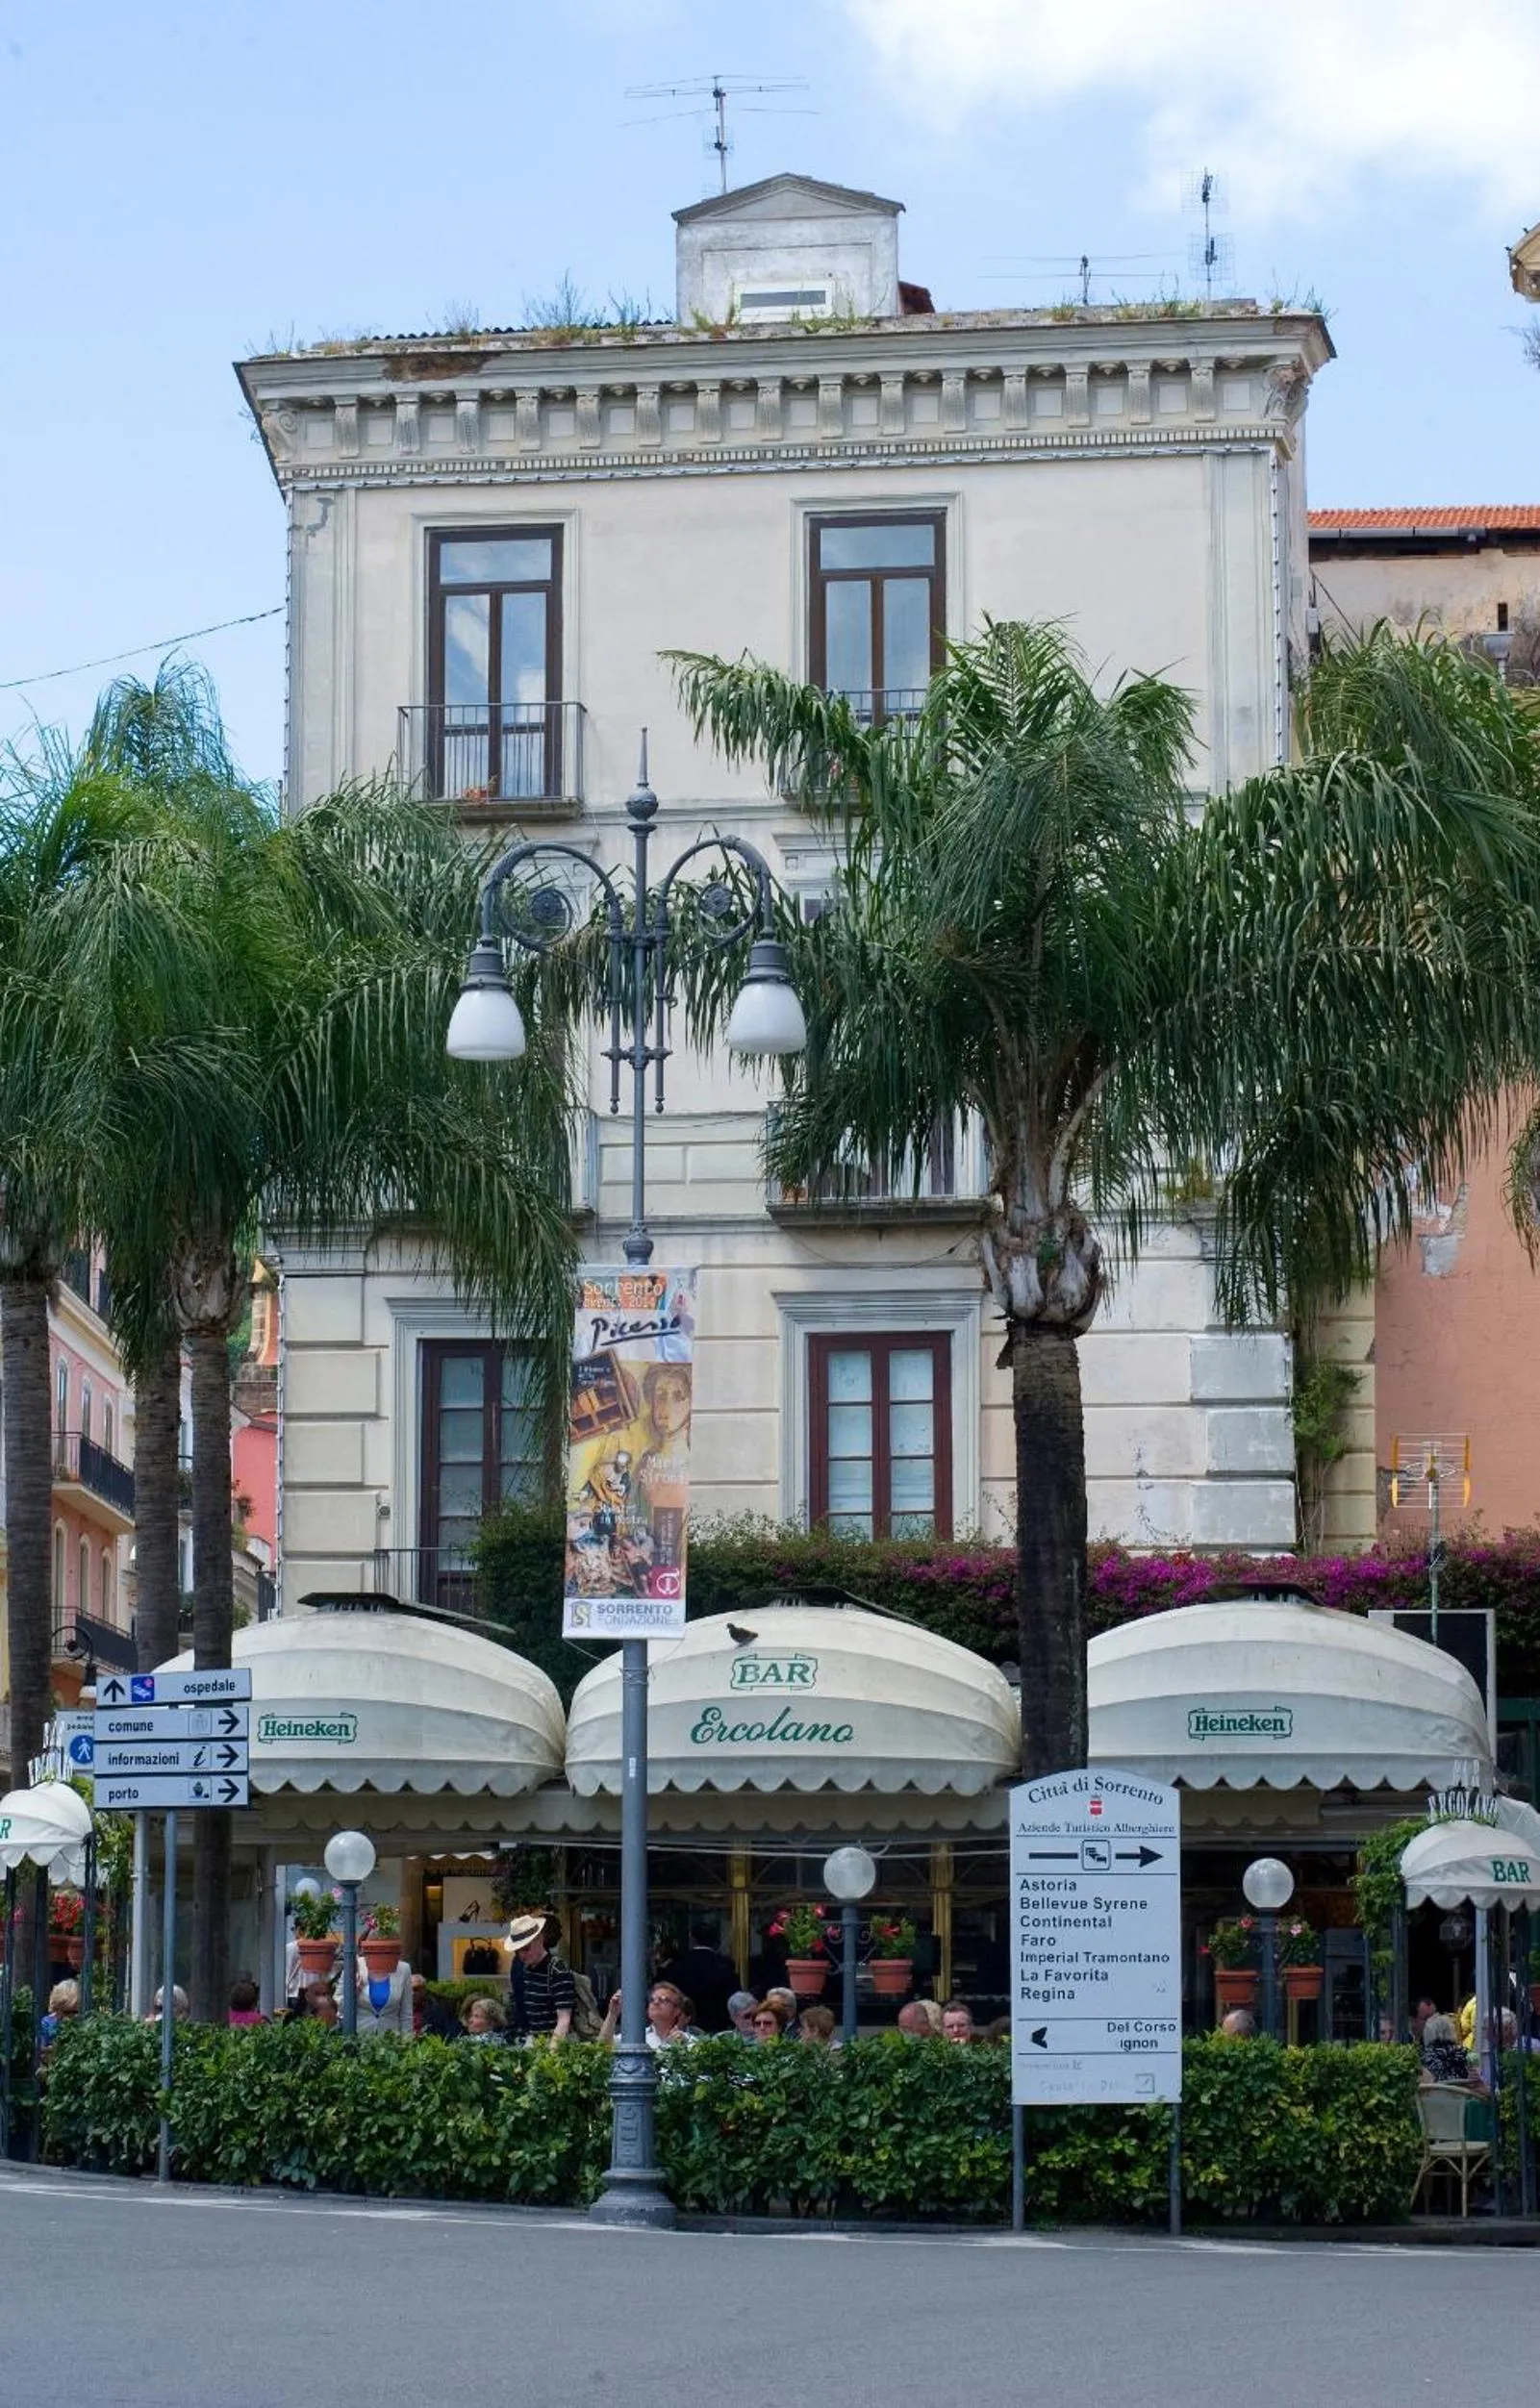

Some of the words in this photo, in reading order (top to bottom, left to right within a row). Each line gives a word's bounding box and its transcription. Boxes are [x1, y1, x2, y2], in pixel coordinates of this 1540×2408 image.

[584, 1278, 664, 1296] Sorrento
[597, 1603, 673, 1615] SORRENTO
[738, 1662, 811, 1684] BAR
[184, 1678, 236, 1694] ospedale
[108, 1721, 154, 1732] comune
[264, 1719, 351, 1737] Heineken
[690, 1705, 855, 1744] Ercolano
[1195, 1714, 1286, 1732] Heineken
[108, 1751, 180, 1766] informazioni
[108, 1787, 139, 1803] porto
[1028, 1780, 1070, 1804] Città
[1073, 1776, 1089, 1793] di
[1094, 1776, 1164, 1806] Sorrento
[1492, 1860, 1532, 1884] BAR
[1020, 1878, 1077, 1892] Astoria
[1020, 1896, 1088, 1910] Bellevue
[1093, 1896, 1148, 1913] Syrene
[1020, 1915, 1112, 1928] Continental
[1021, 1934, 1056, 1946] Faro
[1020, 1951, 1079, 1965] Imperial
[1083, 1951, 1171, 1964] Tramontano
[1021, 1969, 1039, 1982] La
[1045, 1969, 1109, 1982] Favorita
[1021, 1987, 1075, 2002] Regina
[1107, 2021, 1129, 2033] Del
[1134, 2021, 1176, 2033] Corso
